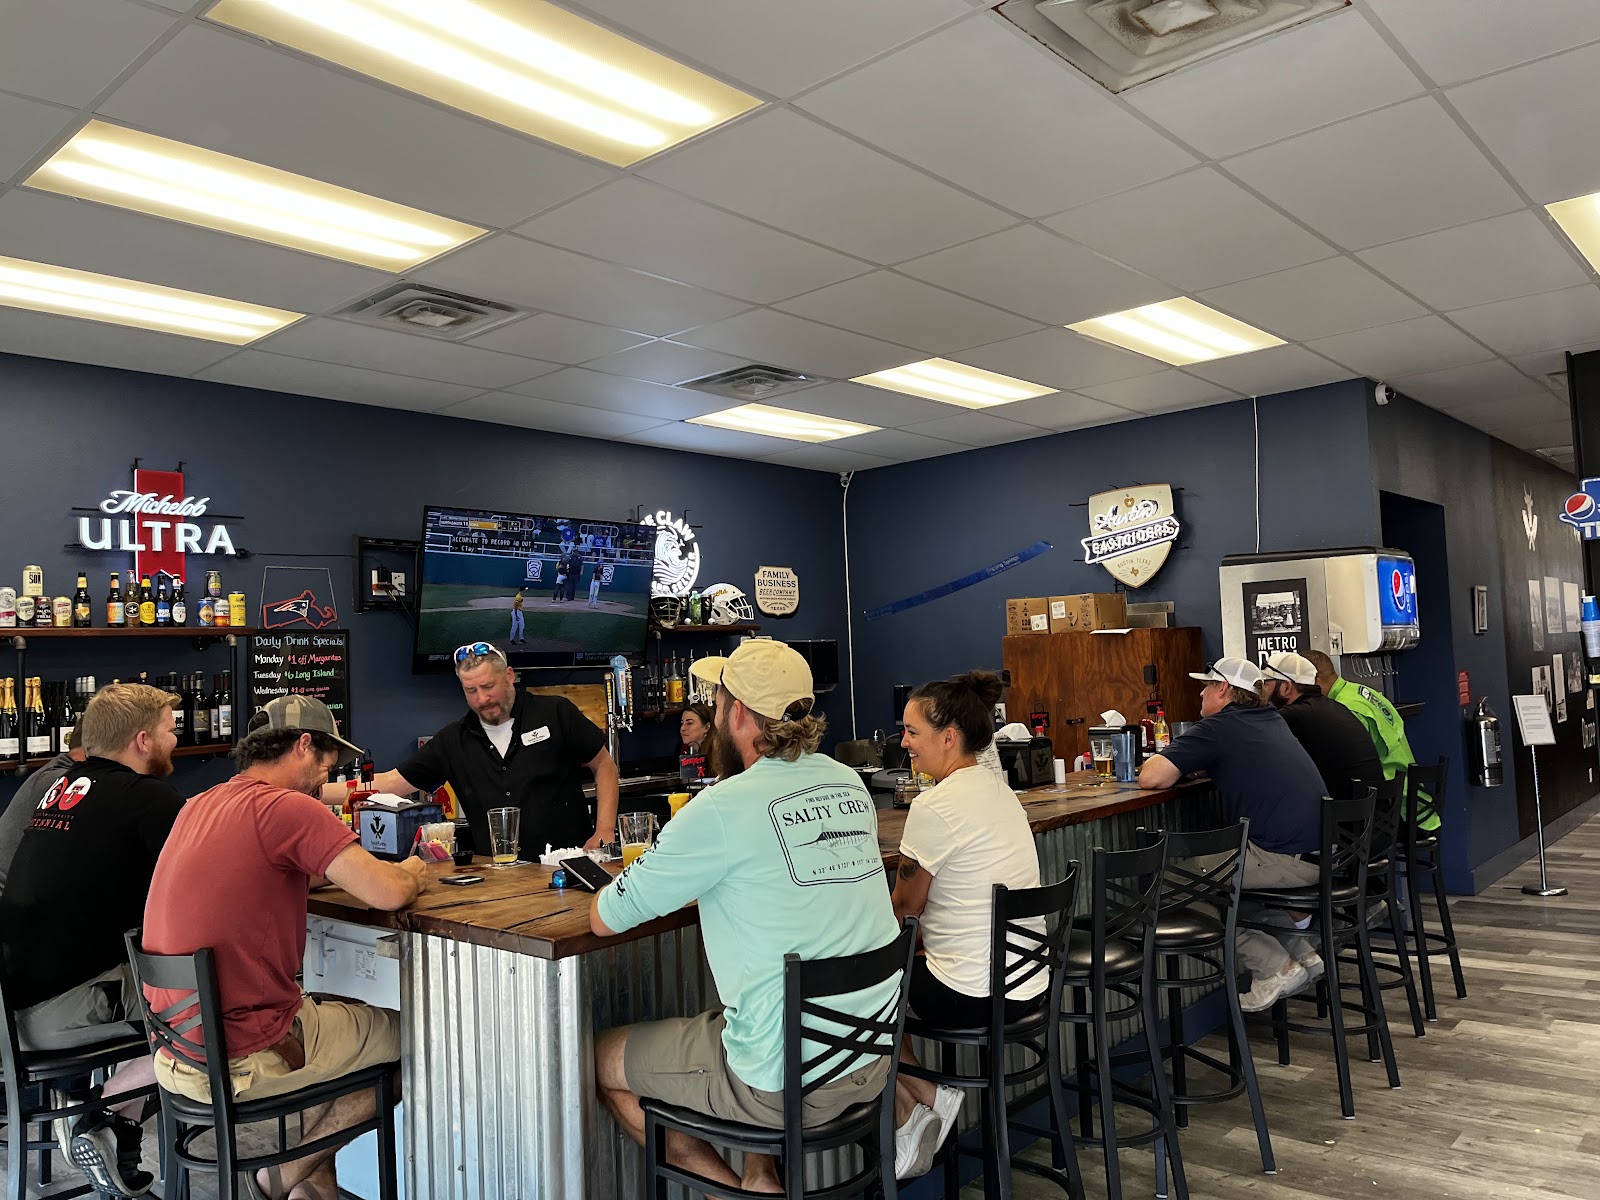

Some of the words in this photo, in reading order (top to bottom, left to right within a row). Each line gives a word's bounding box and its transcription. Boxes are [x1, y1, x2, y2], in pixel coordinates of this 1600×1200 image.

[100, 490, 210, 517] Michelob
[1094, 500, 1158, 530] Austin
[656, 510, 696, 541] CLAW
[79, 517, 236, 555] ULTRA
[1136, 558, 1152, 566] TEXAS
[762, 570, 790, 579] FAMILY
[757, 579, 797, 588] BUSINESS
[759, 588, 772, 596] BEER
[254, 636, 281, 649] Daily
[284, 636, 309, 646] Drink
[313, 636, 343, 648] Specials
[1257, 636, 1297, 651] METRO
[255, 654, 284, 666] Monday
[253, 671, 281, 682] Tuesday
[295, 671, 310, 680] Long
[312, 668, 334, 677] Island
[254, 686, 288, 696] Wednesday
[782, 805, 832, 827] SALTY
[838, 799, 870, 815] CREW
